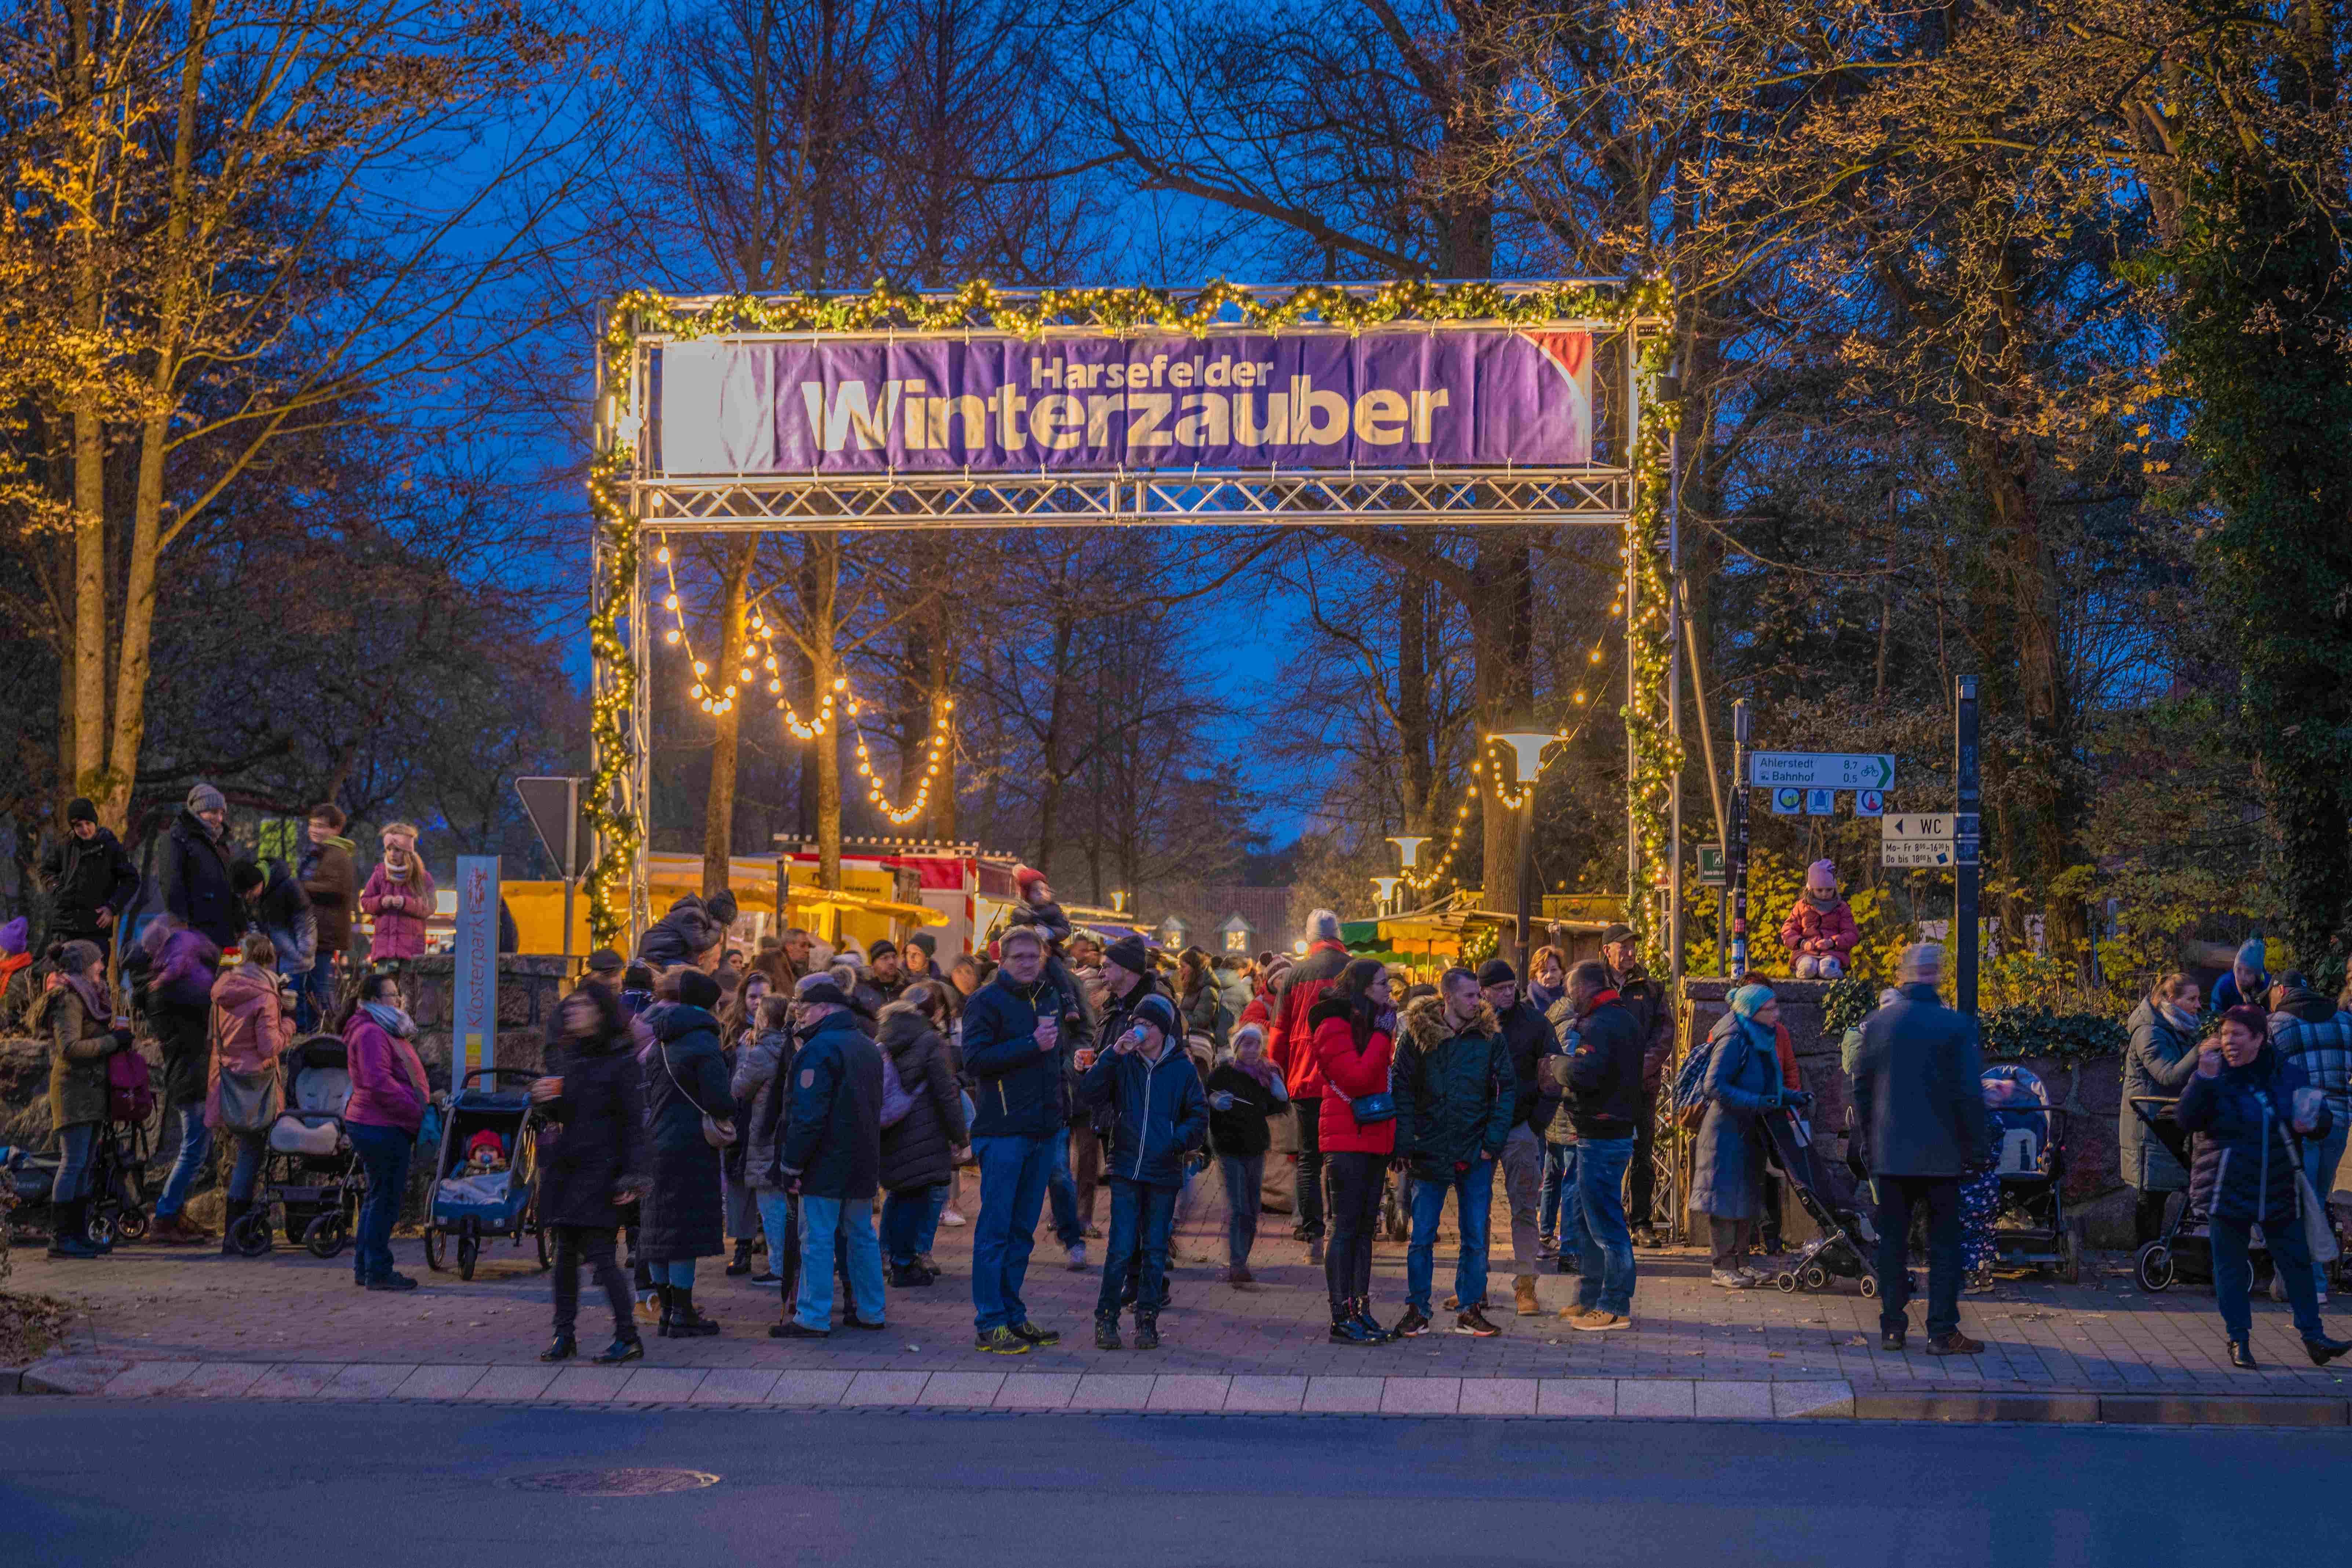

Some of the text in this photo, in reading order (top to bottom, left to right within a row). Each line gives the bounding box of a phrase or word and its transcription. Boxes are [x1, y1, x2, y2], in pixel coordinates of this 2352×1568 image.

[1032, 354, 1274, 389] Harsefelder
[801, 375, 1449, 451] Winterzauber
[1760, 758, 1858, 770] Ahlerstedt 8,7
[1772, 771, 1814, 781] Bahnhof
[1921, 819, 1941, 834] WC
[1904, 843, 1911, 852] Fr
[465, 918, 488, 1027] Klosterpark
